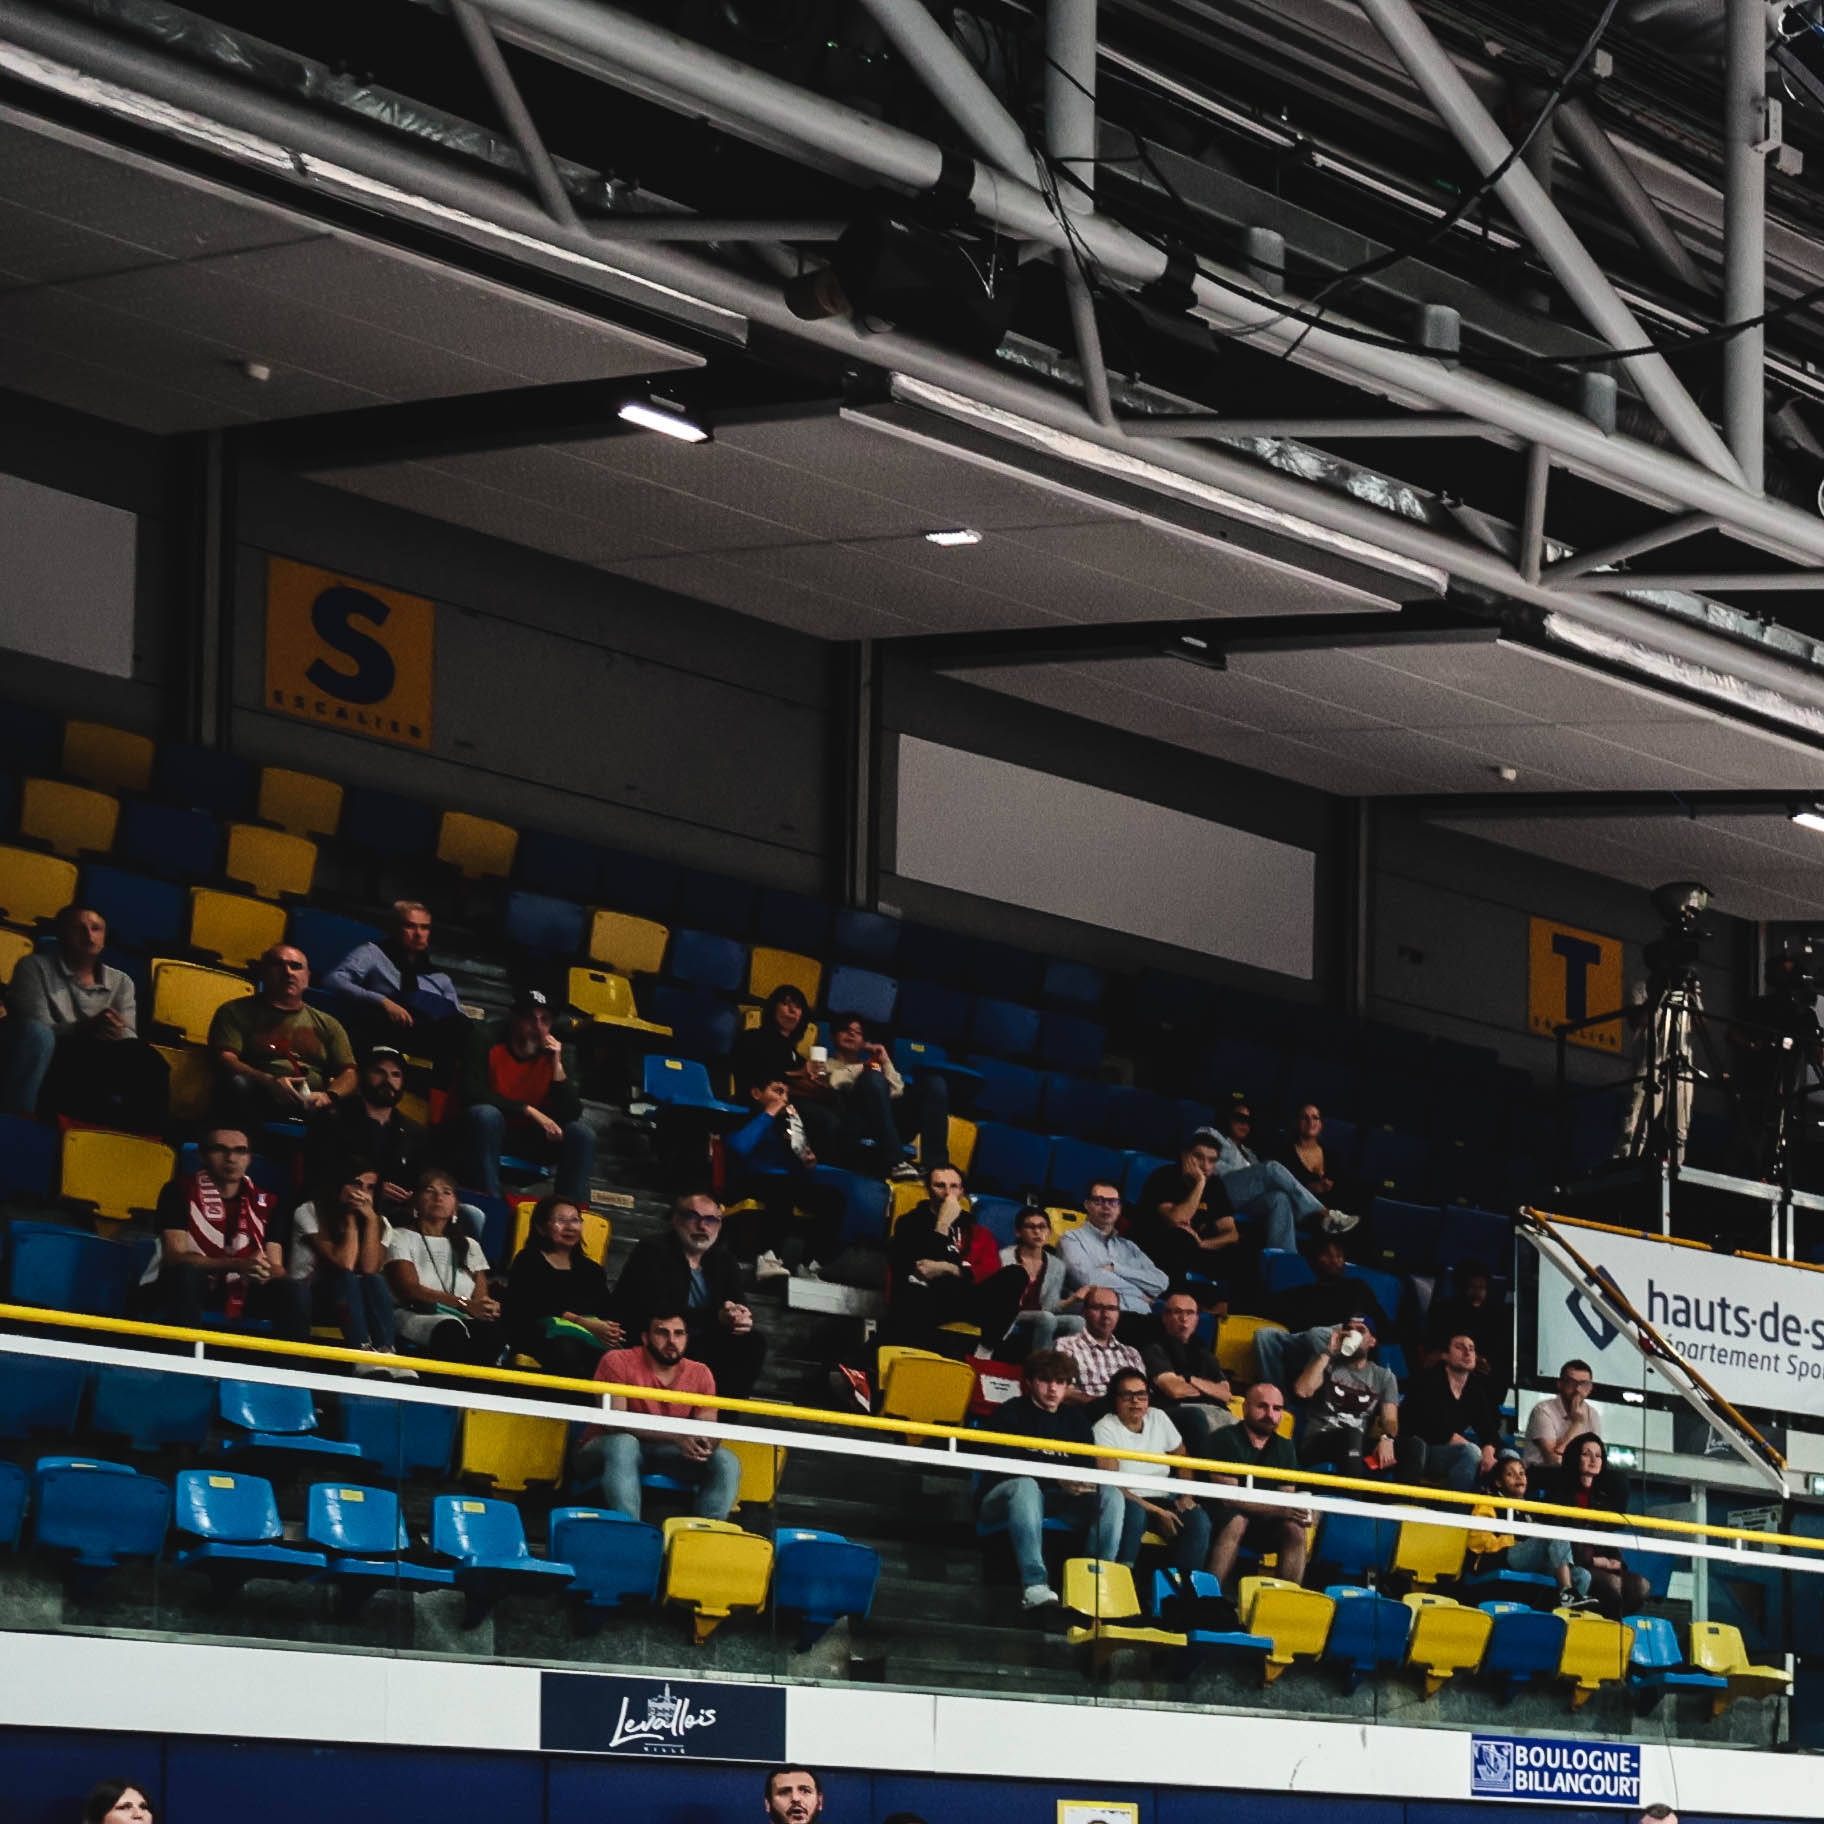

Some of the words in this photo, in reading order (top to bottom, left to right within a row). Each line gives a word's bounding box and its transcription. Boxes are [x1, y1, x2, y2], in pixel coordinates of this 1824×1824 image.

[305, 584, 396, 705] S
[1552, 933, 1601, 1021] T
[608, 1696, 717, 1748] Levallois
[1515, 1744, 1639, 1774] BOULOGNE-
[1515, 1769, 1640, 1798] BILLANCOURT
